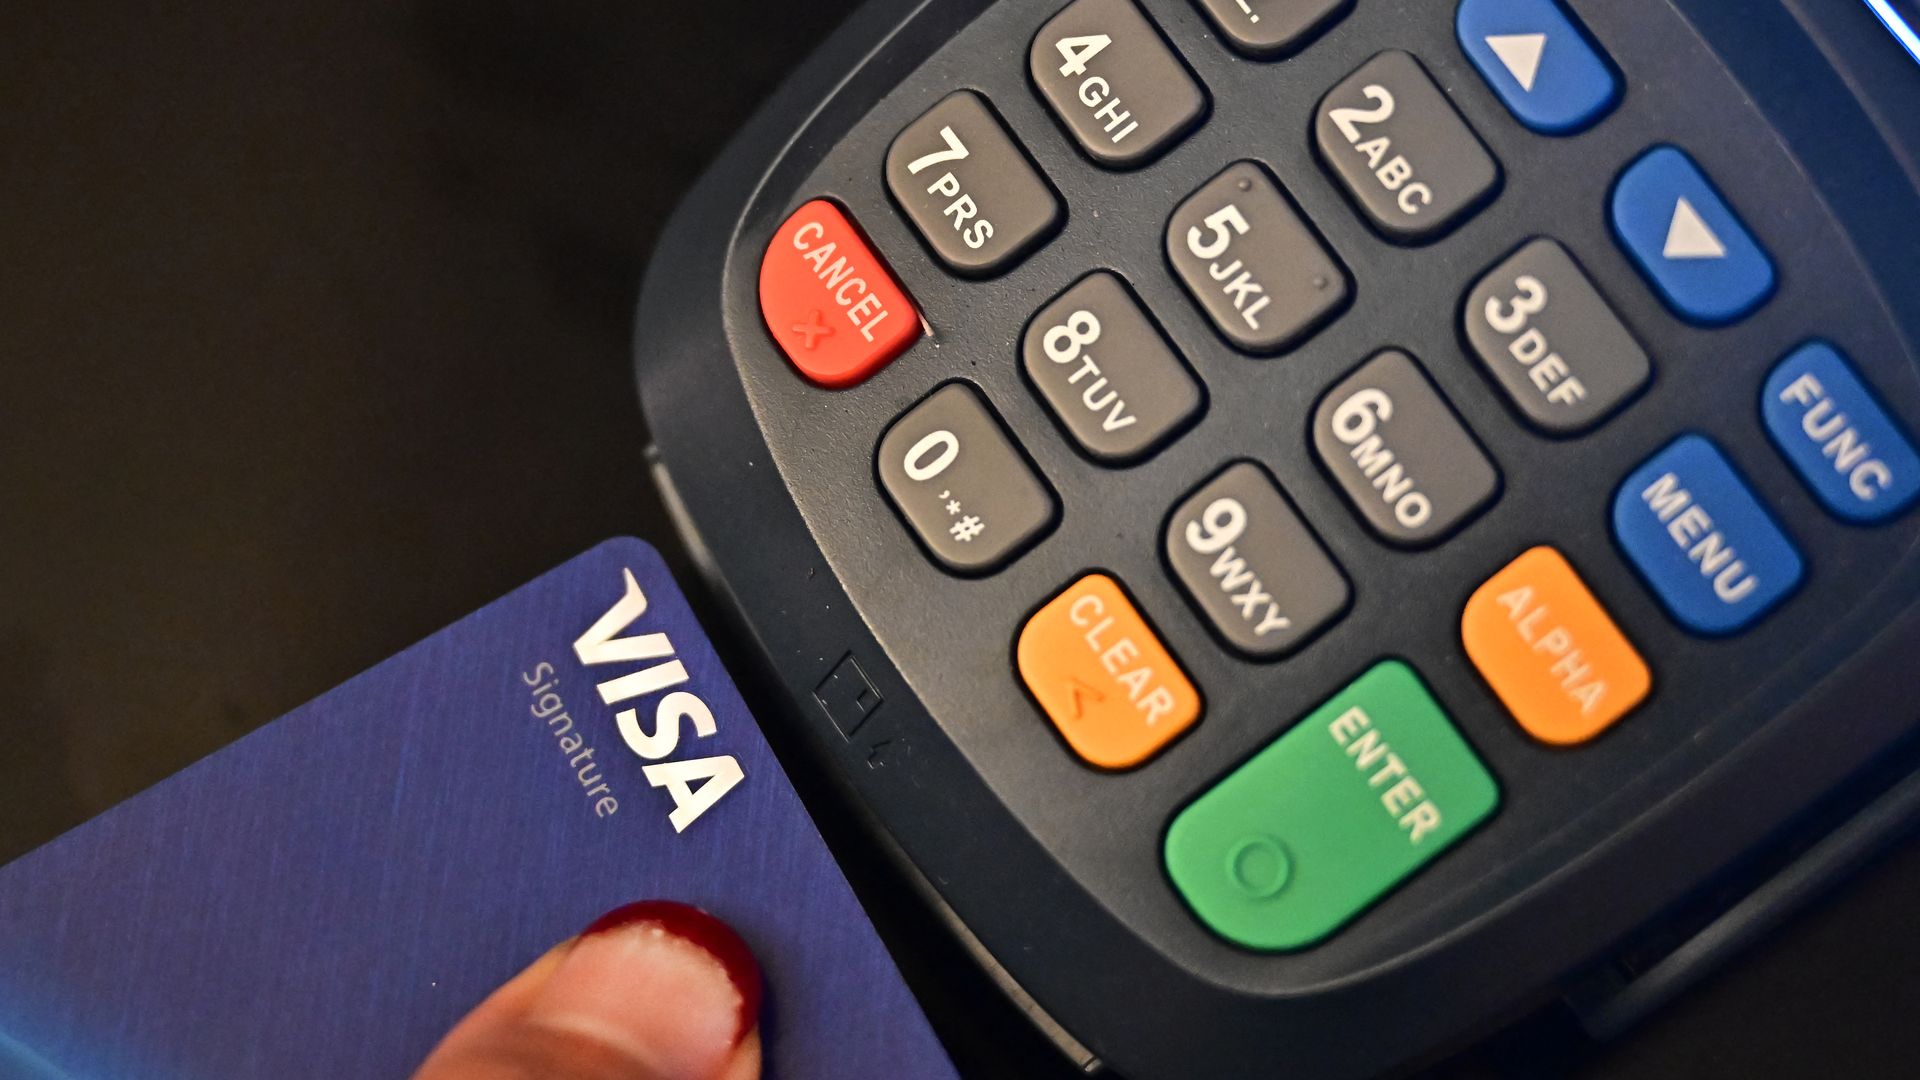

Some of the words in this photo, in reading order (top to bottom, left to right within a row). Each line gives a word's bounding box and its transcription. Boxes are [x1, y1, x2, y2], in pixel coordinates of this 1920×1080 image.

[1054, 33, 1113, 79] 4
[906, 124, 971, 175] 7
[1078, 76, 1139, 144] GHI
[1327, 84, 1396, 144] 2
[926, 171, 995, 249] PRS
[1354, 135, 1433, 216] ABC
[1185, 203, 1251, 261] 5
[793, 221, 890, 343] CANCEL
[1208, 259, 1272, 331] JKL
[1484, 275, 1548, 334] 3
[1043, 310, 1101, 364] 8
[1508, 327, 1586, 406] DEF
[1065, 355, 1138, 434] TUV
[1330, 387, 1394, 445] 6
[904, 430, 960, 481] 0
[1779, 372, 1893, 501] FUNC
[1349, 433, 1433, 530] MNO
[1184, 497, 1248, 555] 9
[1641, 472, 1760, 604] MENU
[1208, 545, 1291, 637] WXY
[1068, 593, 1175, 727] CLEAR
[1496, 584, 1608, 718] ALPHA
[523, 661, 619, 818] Signature
[573, 567, 745, 833] VISA
[1327, 705, 1443, 845] ENTER
